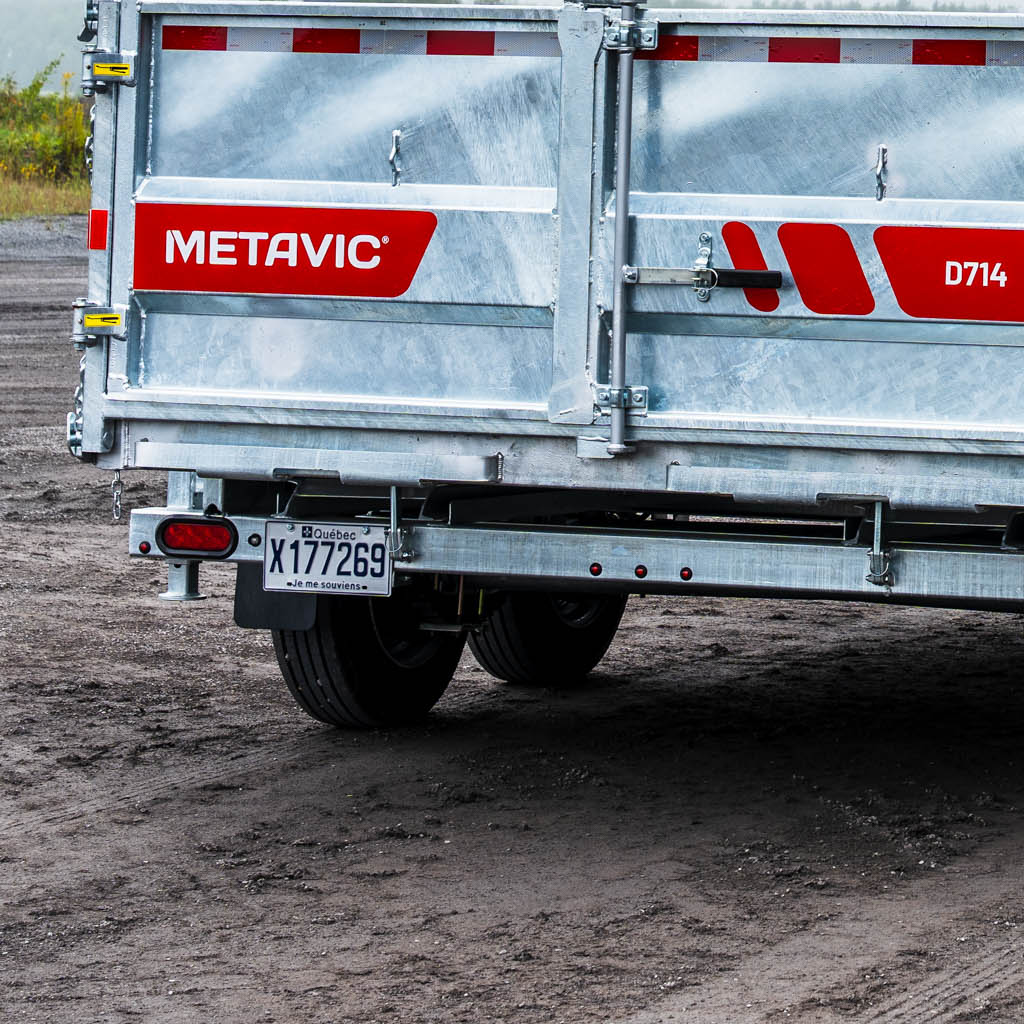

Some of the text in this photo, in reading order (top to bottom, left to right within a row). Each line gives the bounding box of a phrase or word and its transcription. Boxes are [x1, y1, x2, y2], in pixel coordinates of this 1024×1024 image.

[944, 260, 1008, 287] D714
[313, 528, 357, 541] Québec
[269, 538, 386, 578] X177269
[292, 579, 303, 587] Je
[321, 580, 361, 591] souviens
